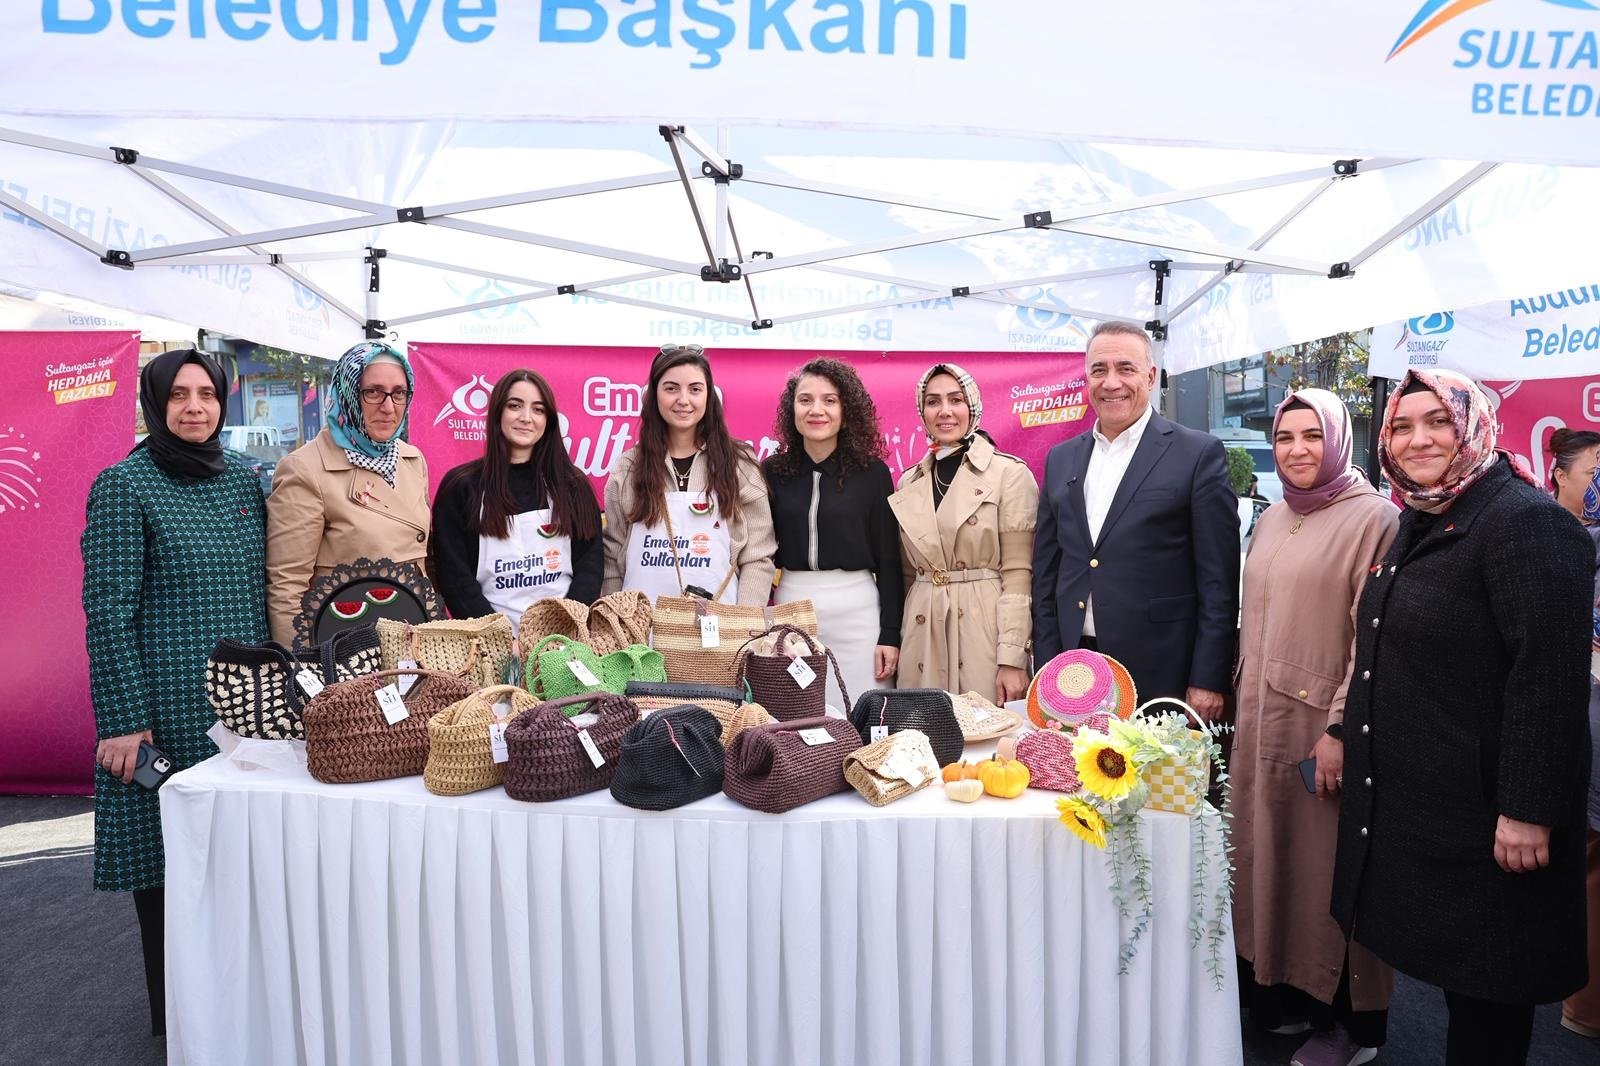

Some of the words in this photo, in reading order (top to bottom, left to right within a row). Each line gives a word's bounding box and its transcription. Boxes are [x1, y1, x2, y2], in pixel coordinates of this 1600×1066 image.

[42, 0, 496, 65] Belediye
[539, 0, 967, 69] Başkanı
[45, 359, 97, 377] Sultangazi
[98, 356, 113, 368] için
[48, 377, 75, 392] HEP
[75, 369, 111, 388] DAHA
[1010, 382, 1066, 399] Sultangazi
[1068, 378, 1086, 390] için
[59, 383, 111, 402] FAZLASI
[1012, 399, 1042, 414] HEP
[1042, 392, 1083, 410] DAHA
[448, 419, 487, 430] SULTAN
[1025, 407, 1083, 426] FAZLASI
[454, 431, 487, 442] BELEDİY
[495, 554, 543, 574] Emeğin
